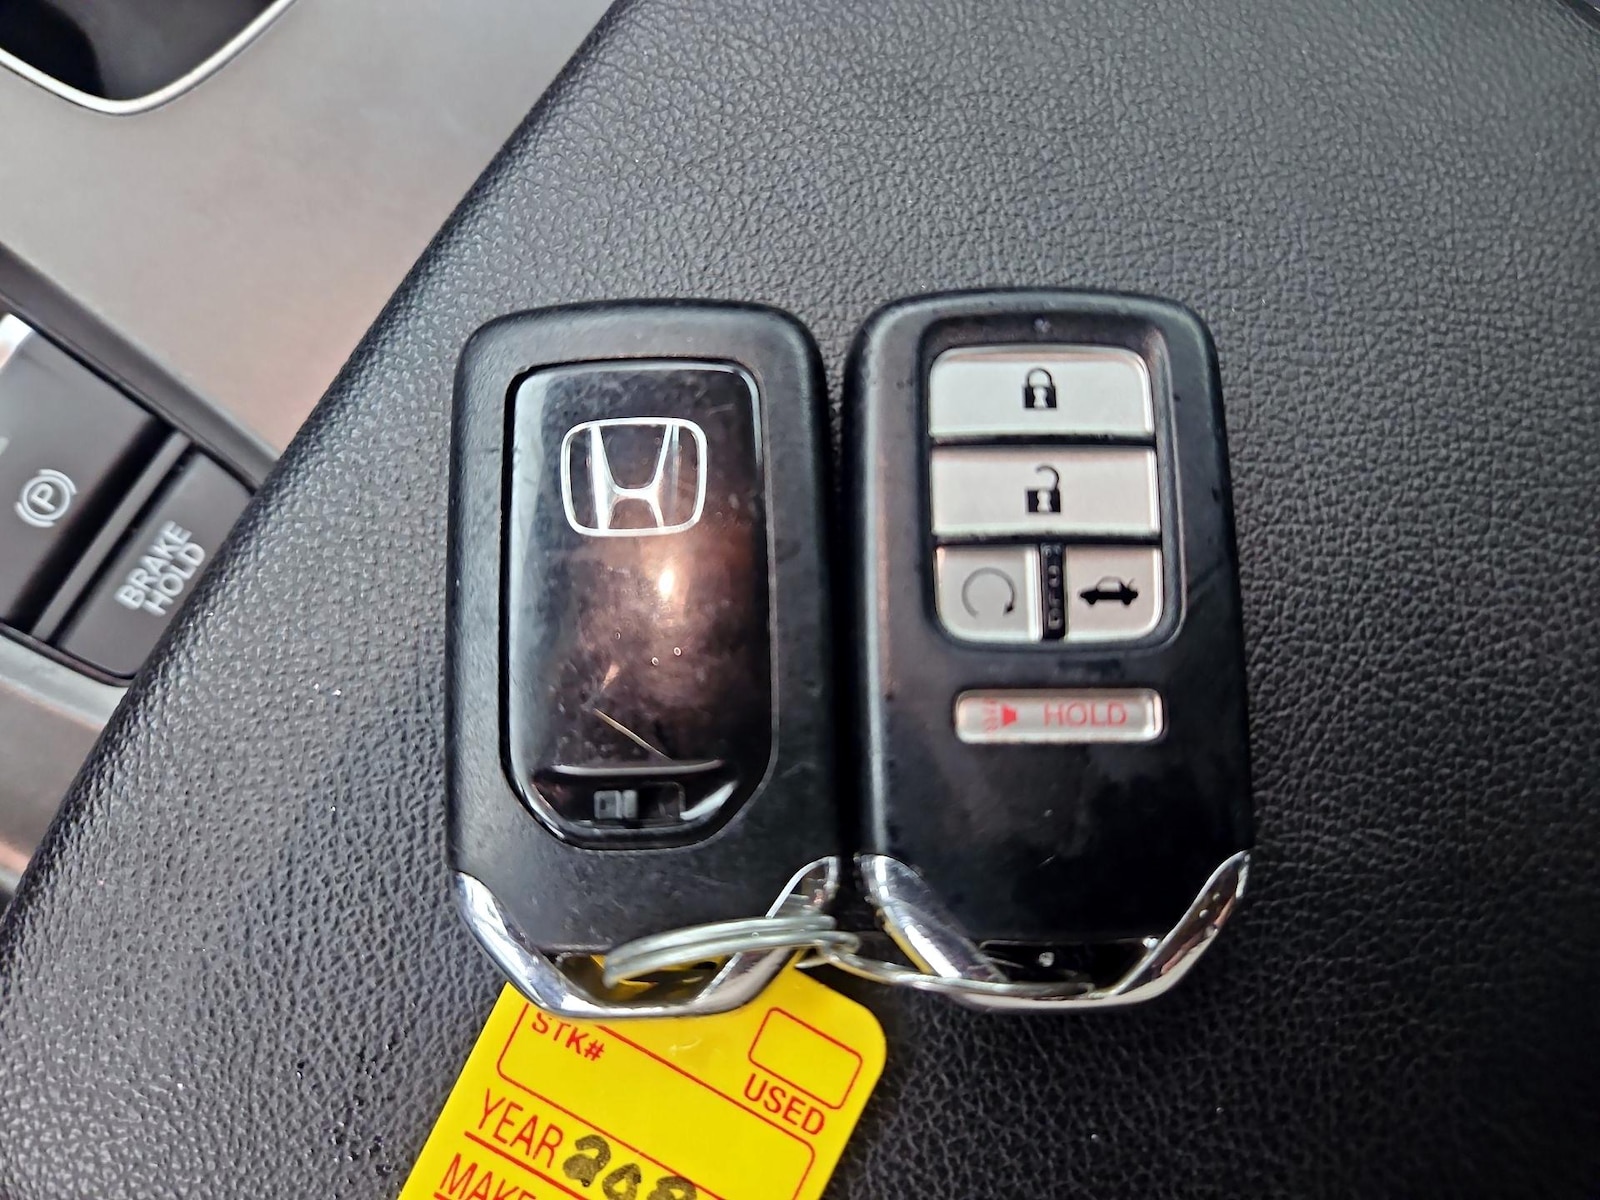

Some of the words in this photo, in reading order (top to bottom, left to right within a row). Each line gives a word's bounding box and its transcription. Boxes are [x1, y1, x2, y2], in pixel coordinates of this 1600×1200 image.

[114, 520, 193, 610] BRAKE
[142, 541, 206, 617] HOLD
[1043, 702, 1128, 728] HOLD
[531, 1011, 605, 1061] STK#
[478, 1087, 564, 1169] YEAR
[744, 1072, 825, 1135] USED
[439, 1152, 537, 1200] MAK
